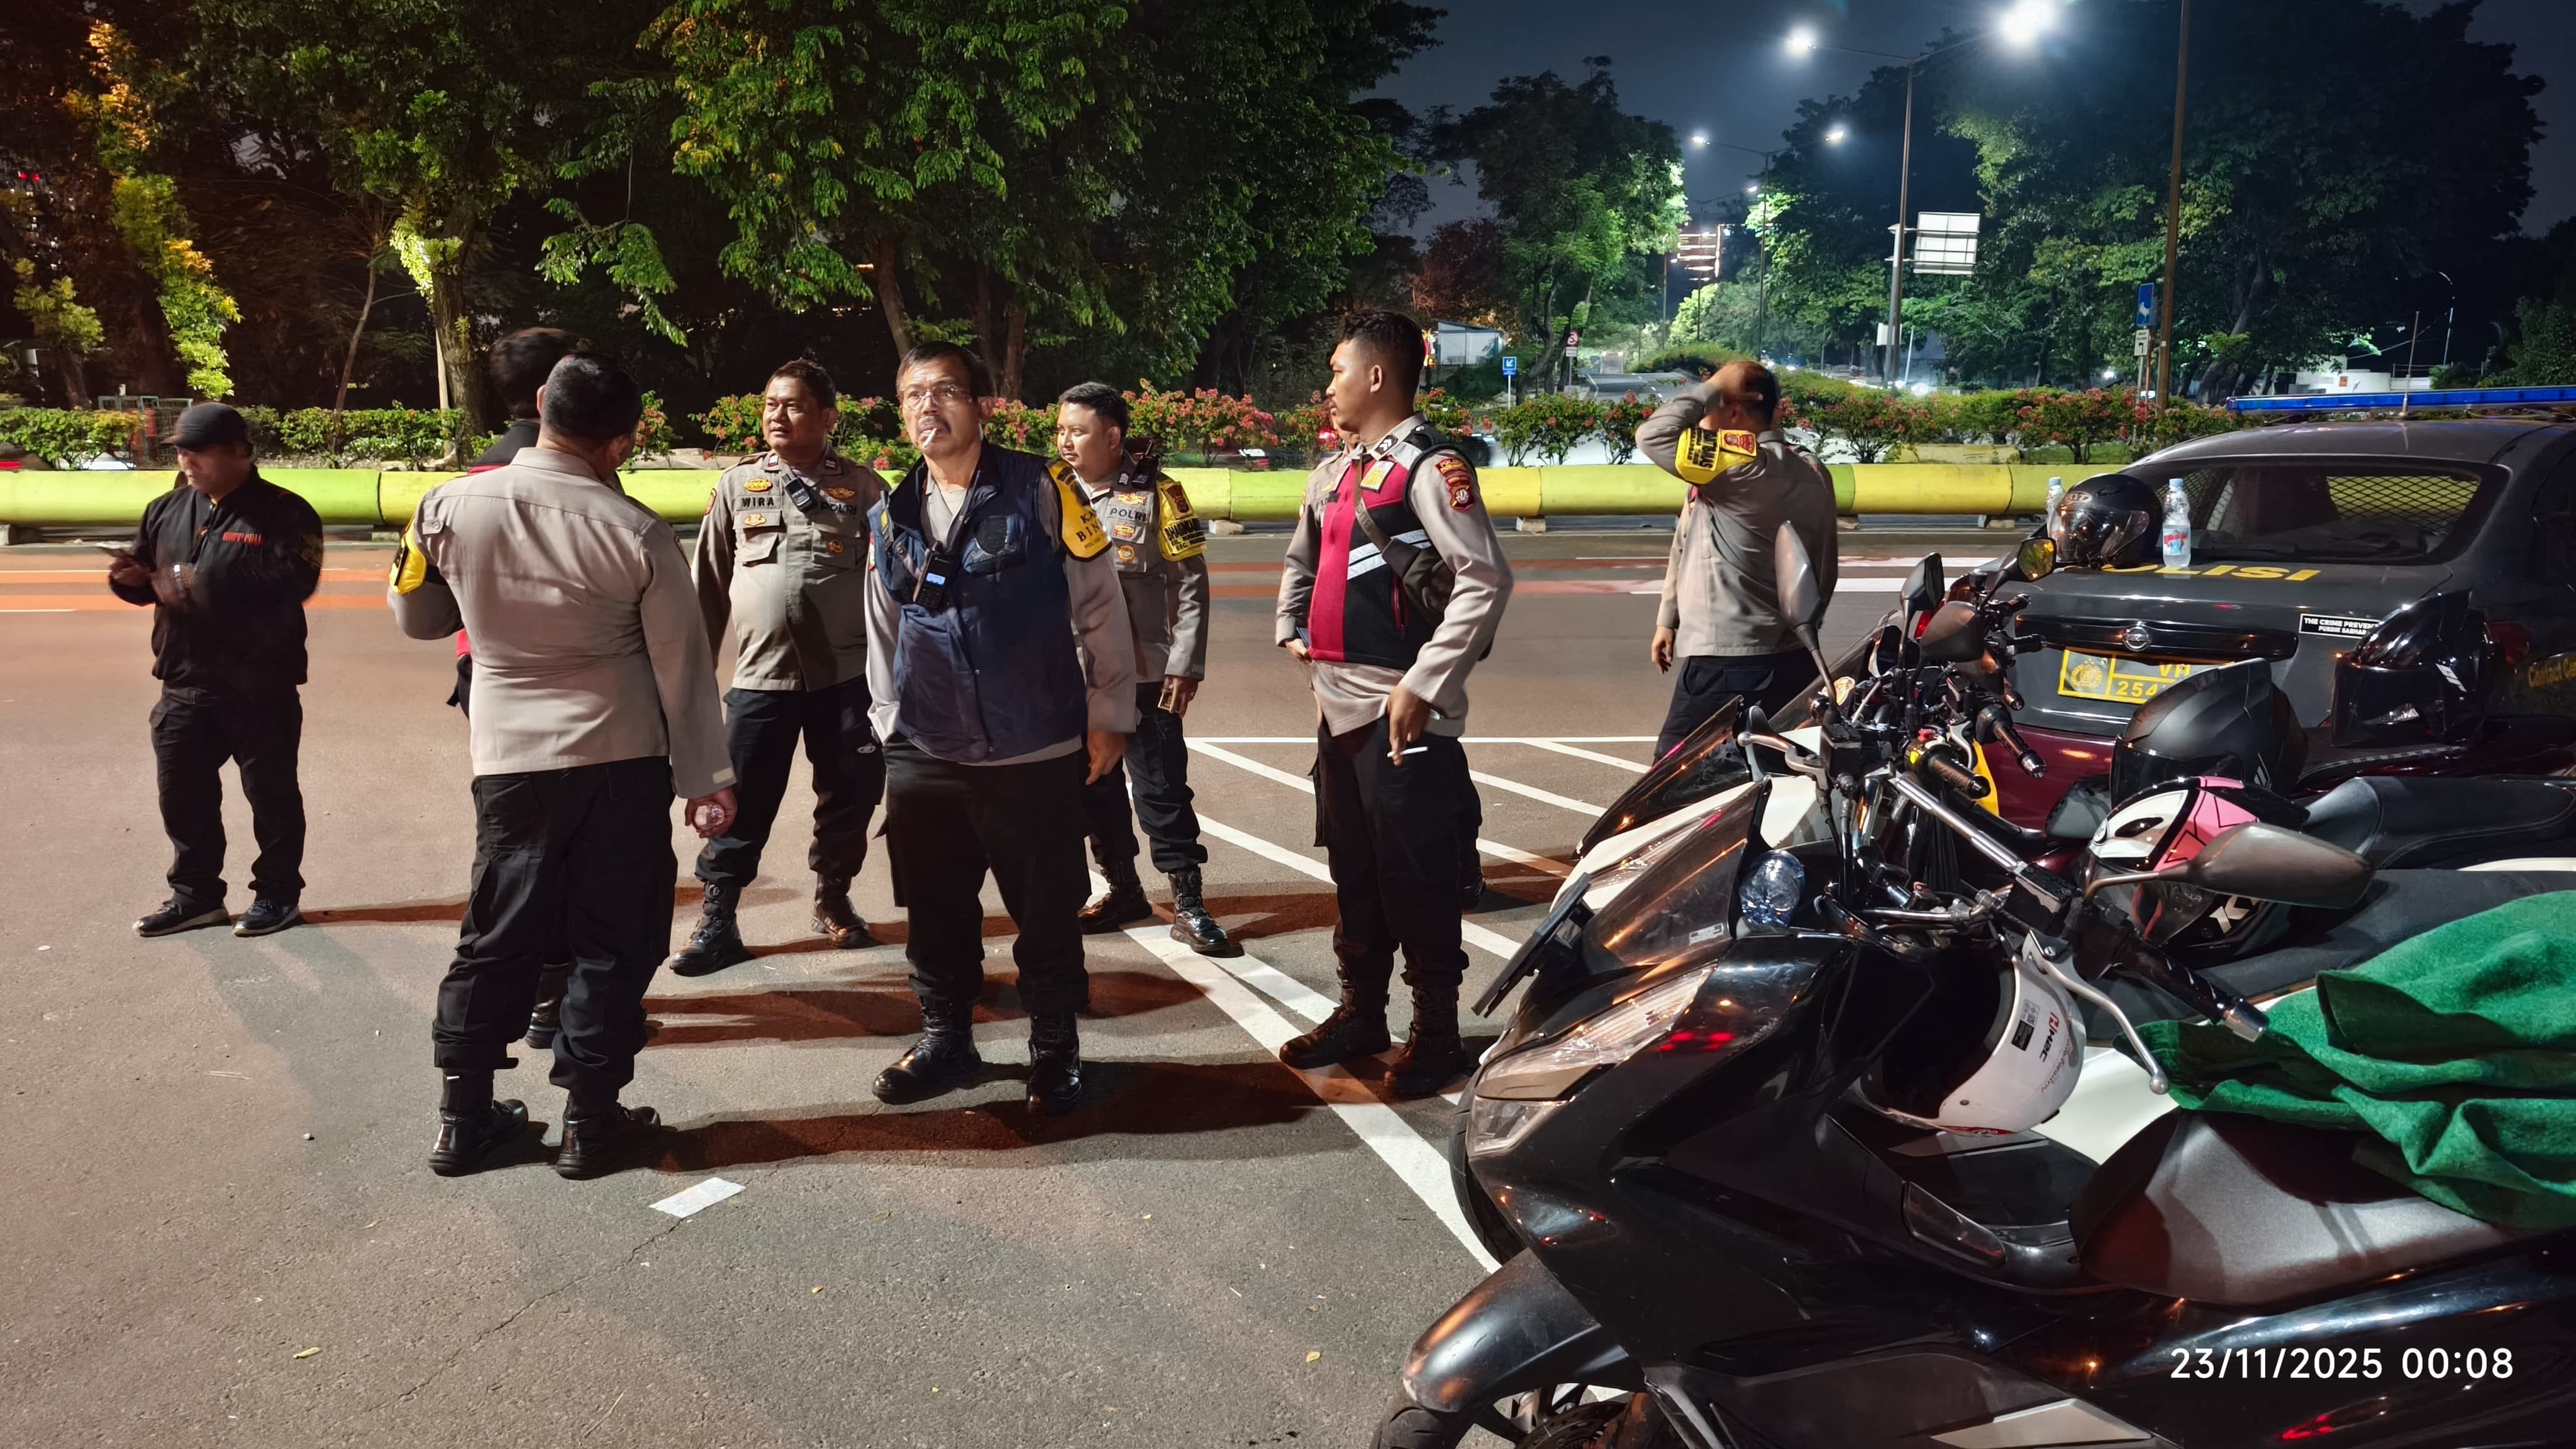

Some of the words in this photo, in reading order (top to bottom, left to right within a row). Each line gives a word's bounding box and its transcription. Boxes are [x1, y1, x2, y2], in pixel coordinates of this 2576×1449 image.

[741, 496, 775, 508] WIRA
[820, 502, 857, 515] POLRI
[1109, 508, 1147, 523] POLRI
[2101, 564, 2322, 581] OLISI
